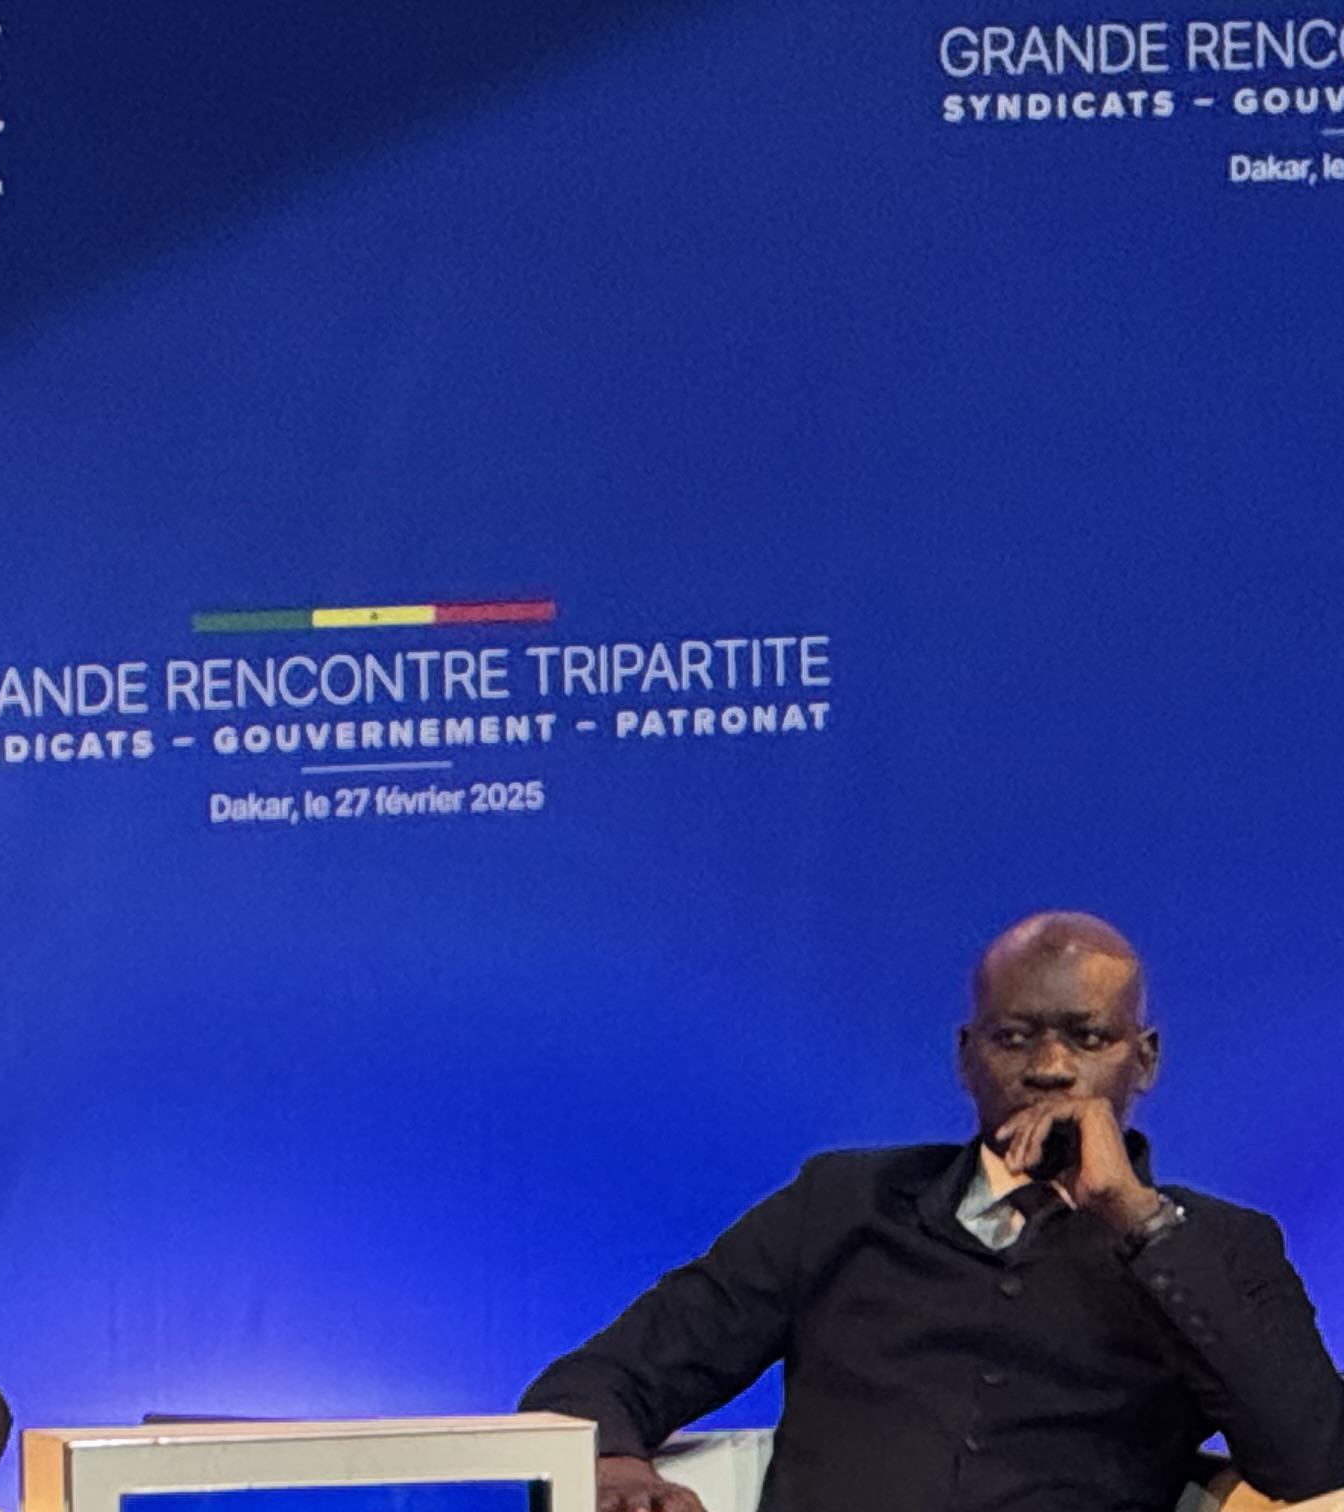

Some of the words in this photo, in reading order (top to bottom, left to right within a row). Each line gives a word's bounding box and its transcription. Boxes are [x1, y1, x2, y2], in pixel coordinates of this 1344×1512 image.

[940, 22, 1169, 78] GRANDE
[943, 90, 1174, 122] SYNDICATS
[1230, 154, 1317, 185] Dakar,
[166, 648, 510, 711] RENCONTRE
[526, 635, 831, 696] TRIPARTITE
[213, 713, 556, 754] GOUVERNEMENT
[616, 702, 830, 738] PATRONAT
[210, 793, 299, 824] Dakar,
[304, 790, 330, 818] le
[335, 787, 371, 817] 27
[374, 785, 466, 815] février
[470, 780, 545, 812] 2025
